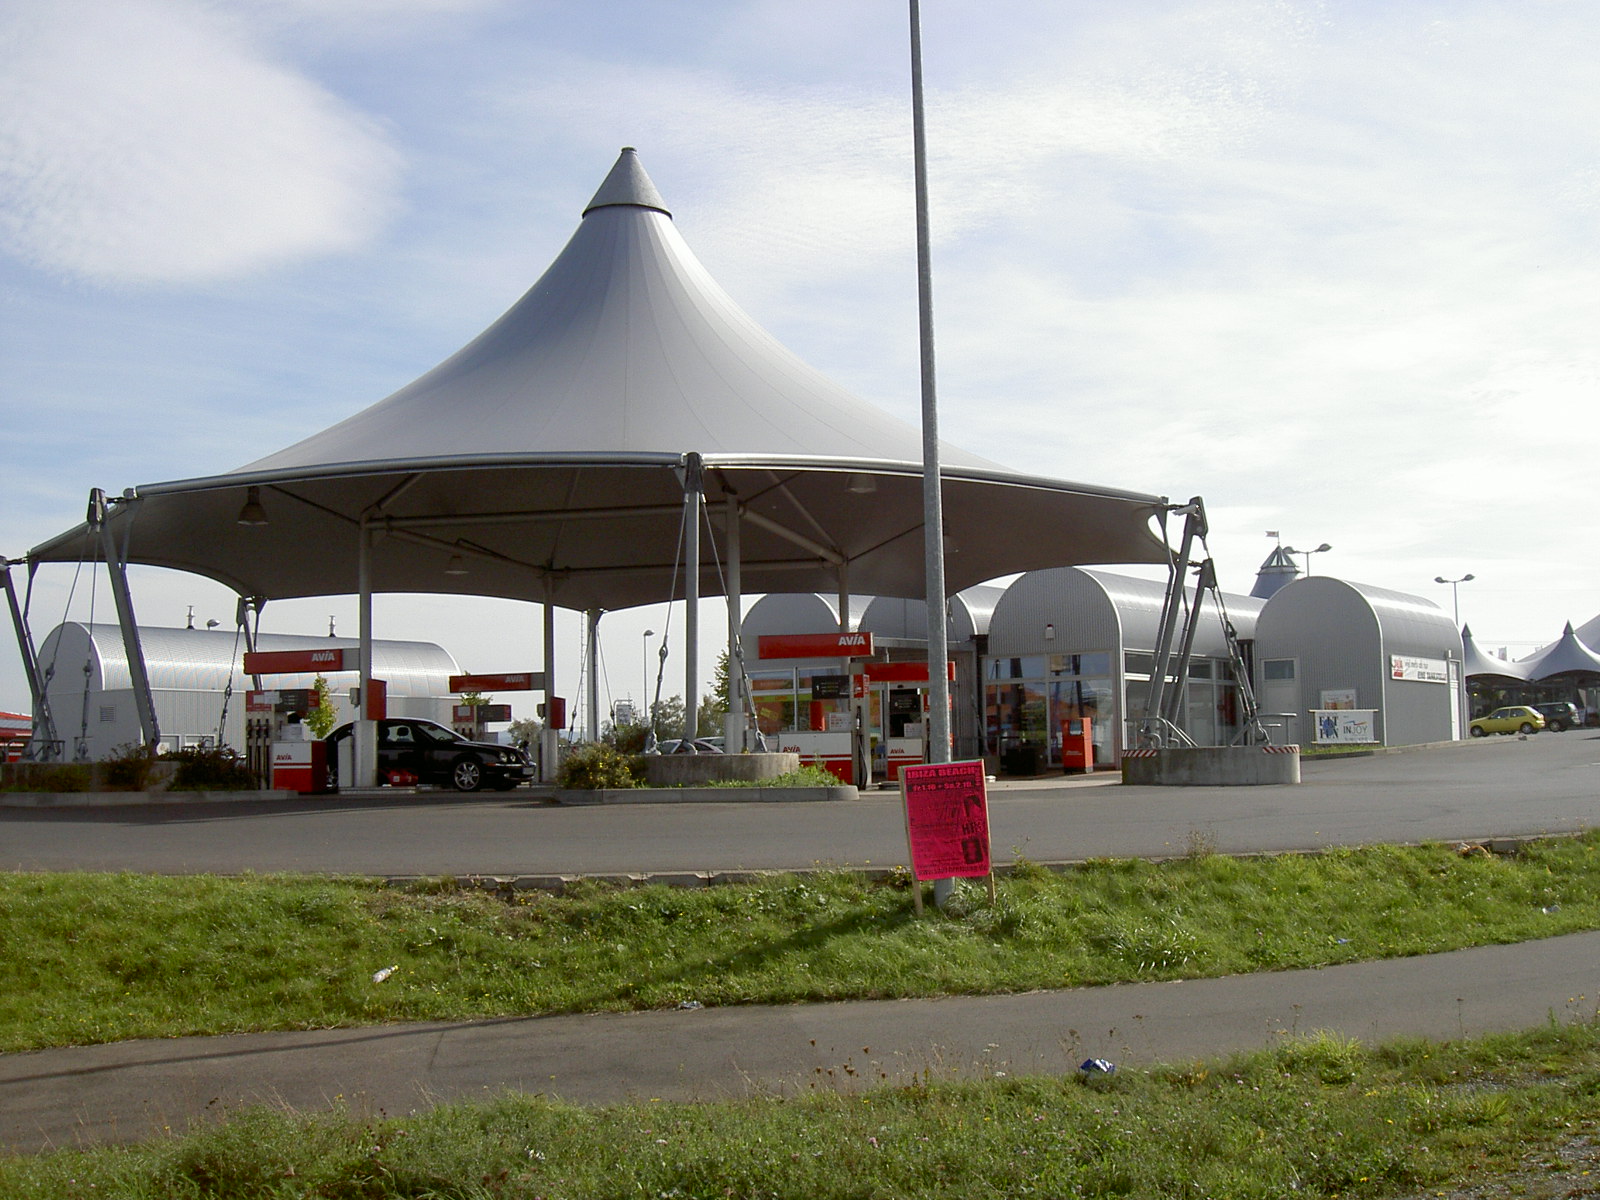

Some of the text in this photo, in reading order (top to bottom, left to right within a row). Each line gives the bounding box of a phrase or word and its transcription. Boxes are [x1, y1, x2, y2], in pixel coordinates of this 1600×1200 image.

[1343, 725, 1368, 734] INJOY
[907, 769, 936, 779] IBIZA
[938, 766, 975, 777] BEACH
